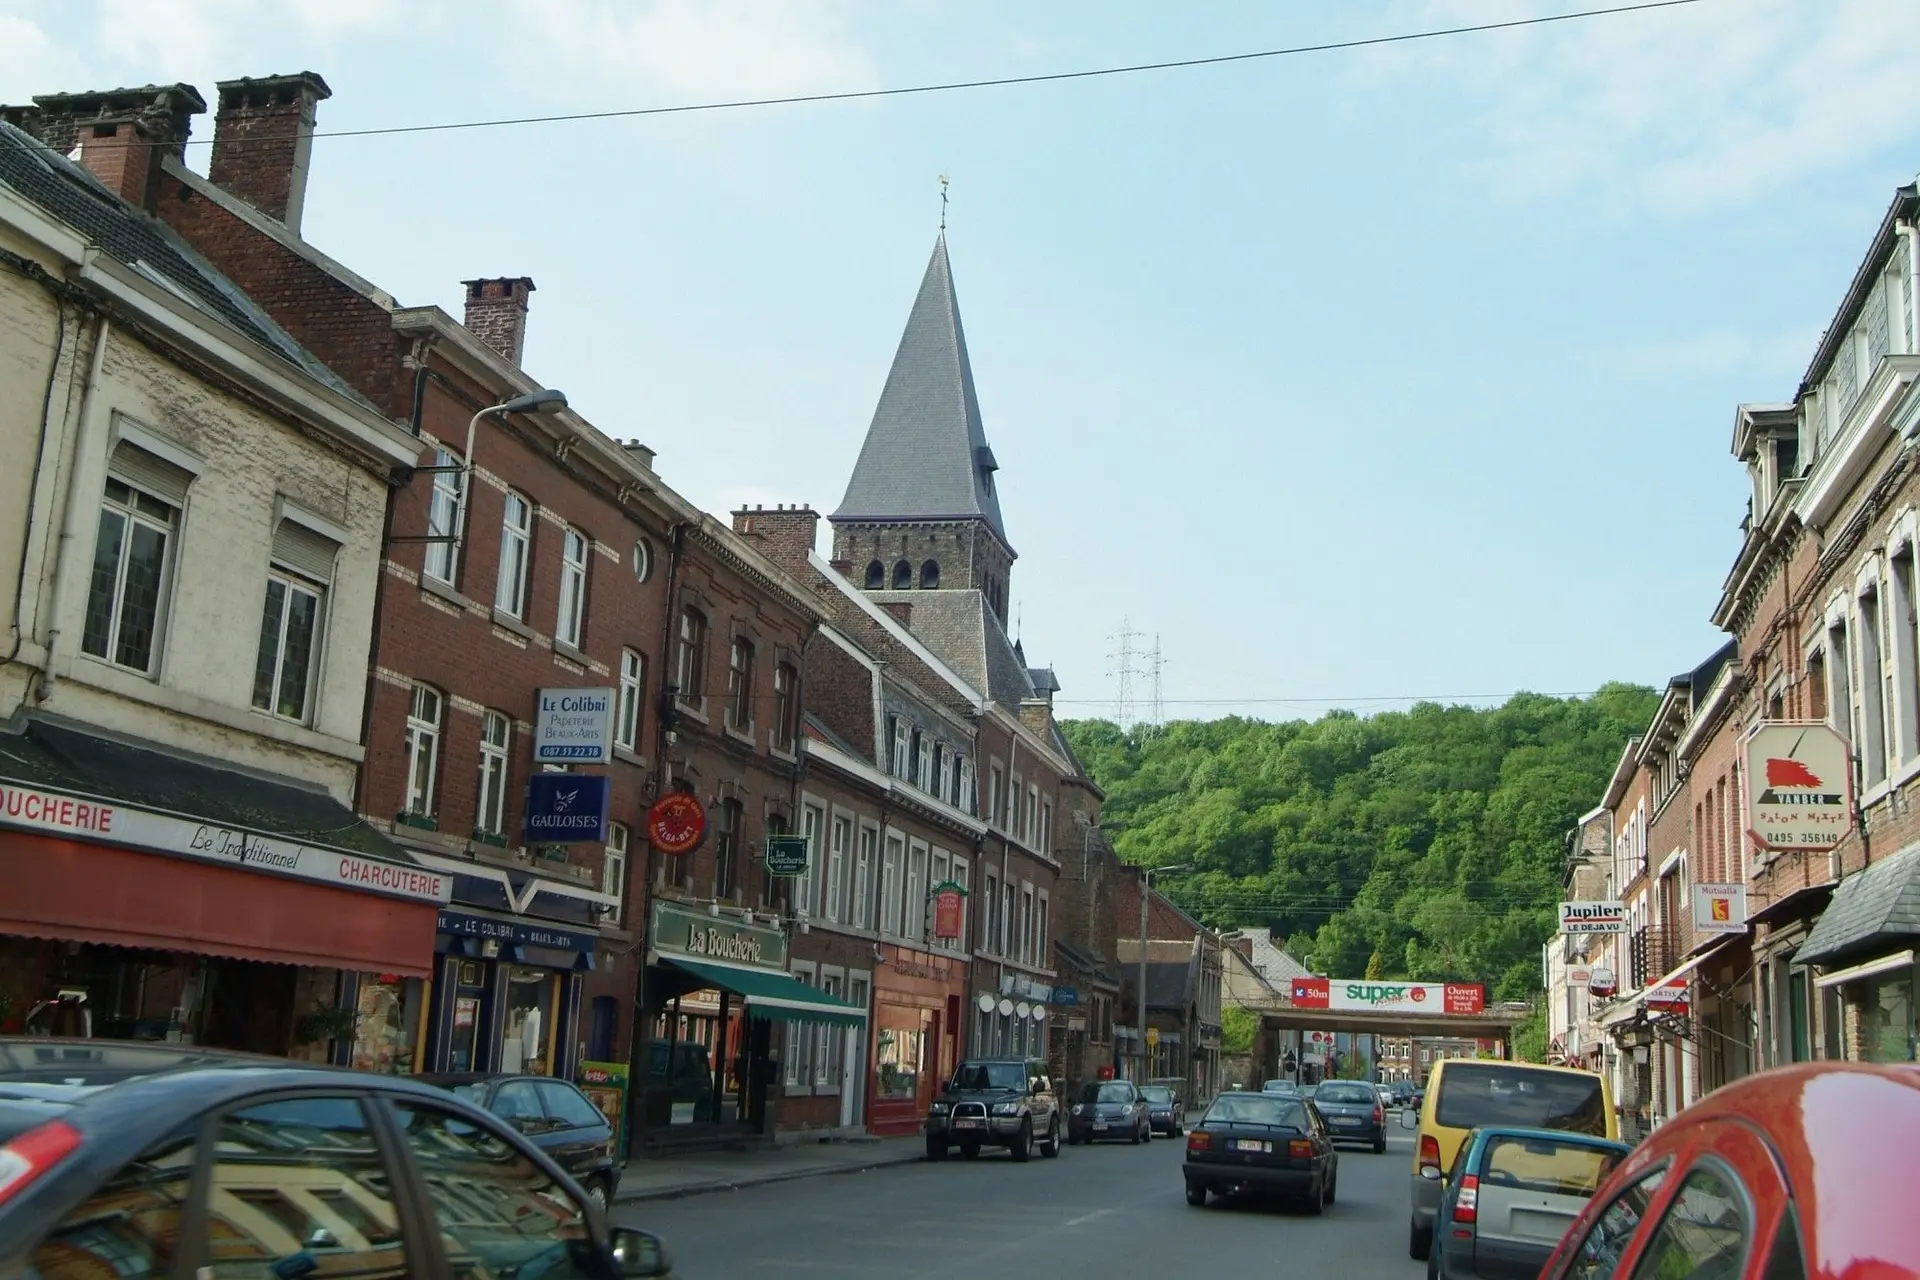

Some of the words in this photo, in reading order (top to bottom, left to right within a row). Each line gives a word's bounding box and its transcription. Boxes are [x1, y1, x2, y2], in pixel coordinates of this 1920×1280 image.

[543, 697, 557, 712] Le
[562, 697, 606, 712] Colibri
[1777, 794, 1825, 806] VANBER
[0, 787, 113, 833] UCHERIE
[531, 814, 599, 829] GAULOISES
[1761, 813, 1798, 823] SALON
[1808, 813, 1844, 823] MIXTE
[1767, 832, 1793, 843] 0495
[1802, 832, 1838, 844] 356149
[190, 826, 213, 852] Le
[215, 830, 303, 870] Traditionnel
[340, 857, 441, 896] CHARCUTERIE
[1701, 886, 1737, 895] Mutualia
[1563, 904, 1622, 920] Jupiler
[465, 921, 477, 933] LE
[482, 923, 514, 938] COLIBRI
[1567, 924, 1579, 932] LE
[1606, 923, 1620, 931] VU
[688, 923, 706, 952] La
[708, 928, 761, 963] Boucherie
[1307, 988, 1328, 999] 50m
[1346, 984, 1406, 1005] super
[1447, 986, 1478, 996] Ouvert
[1648, 990, 1676, 998] ORTIS
